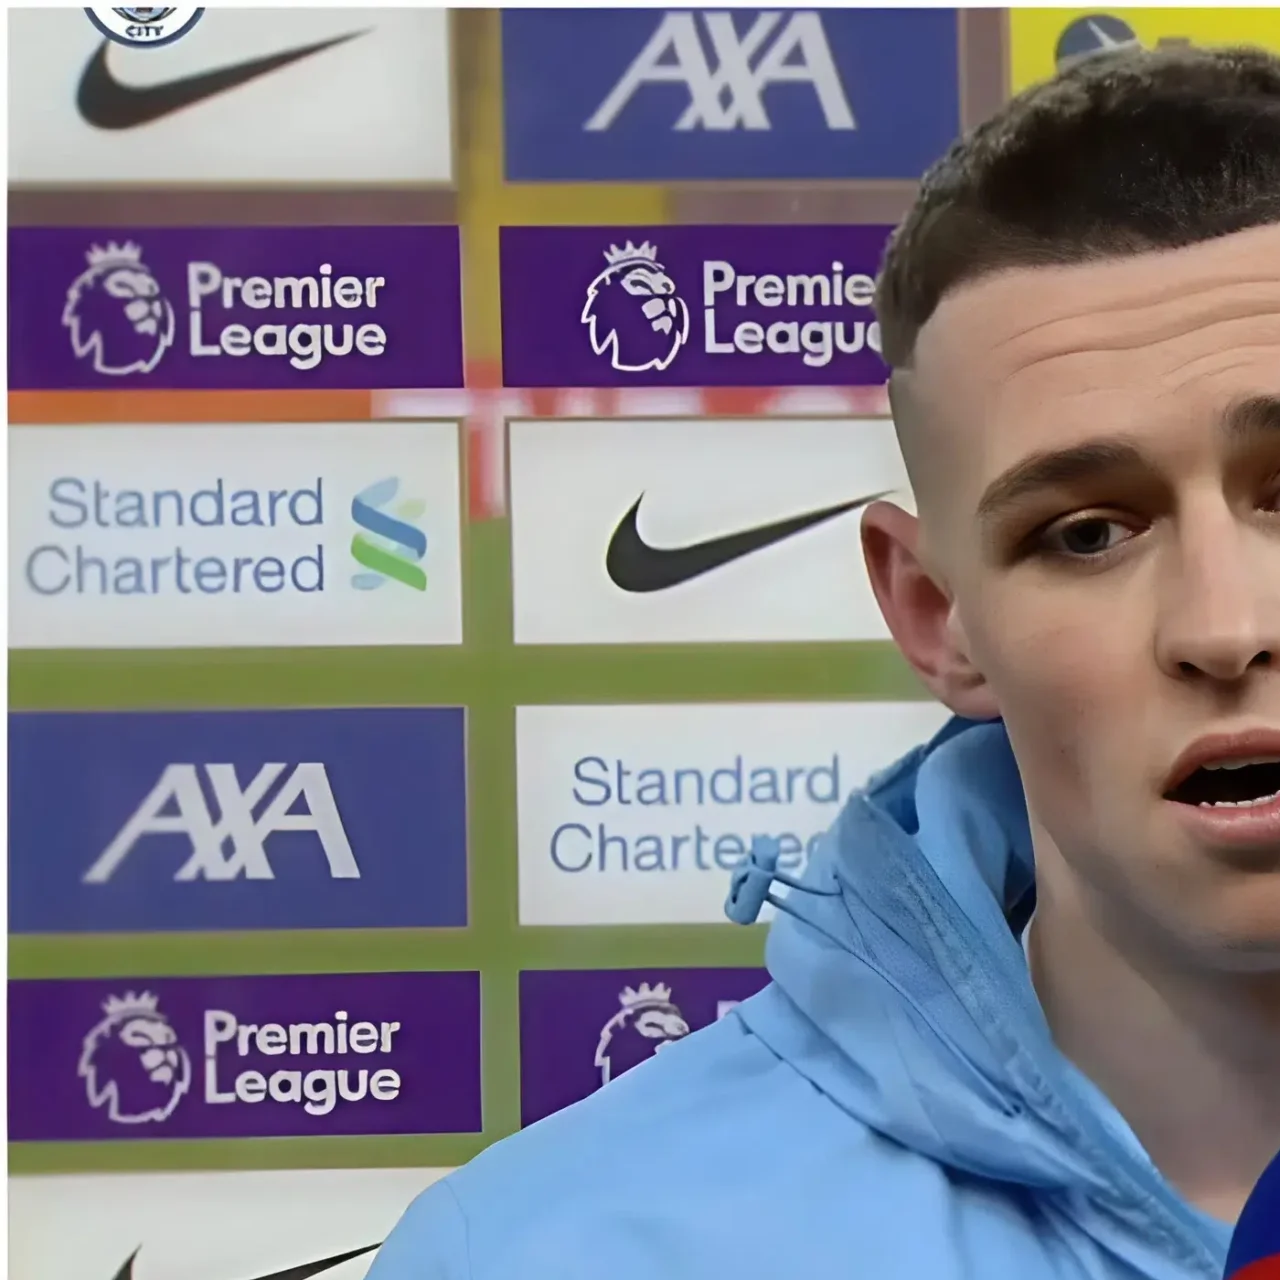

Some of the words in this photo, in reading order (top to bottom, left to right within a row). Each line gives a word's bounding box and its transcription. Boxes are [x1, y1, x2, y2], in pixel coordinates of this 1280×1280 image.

[586, 11, 856, 131] AXA
[188, 262, 386, 310] Premier
[703, 260, 877, 307] Premie
[189, 310, 387, 370] League
[48, 476, 324, 529] Standard
[25, 543, 325, 597] Chartered
[572, 752, 840, 806] Standard
[84, 762, 361, 883] AXA
[550, 823, 826, 872] Chartee
[204, 1010, 401, 1057] Premier
[205, 1057, 401, 1116] League
